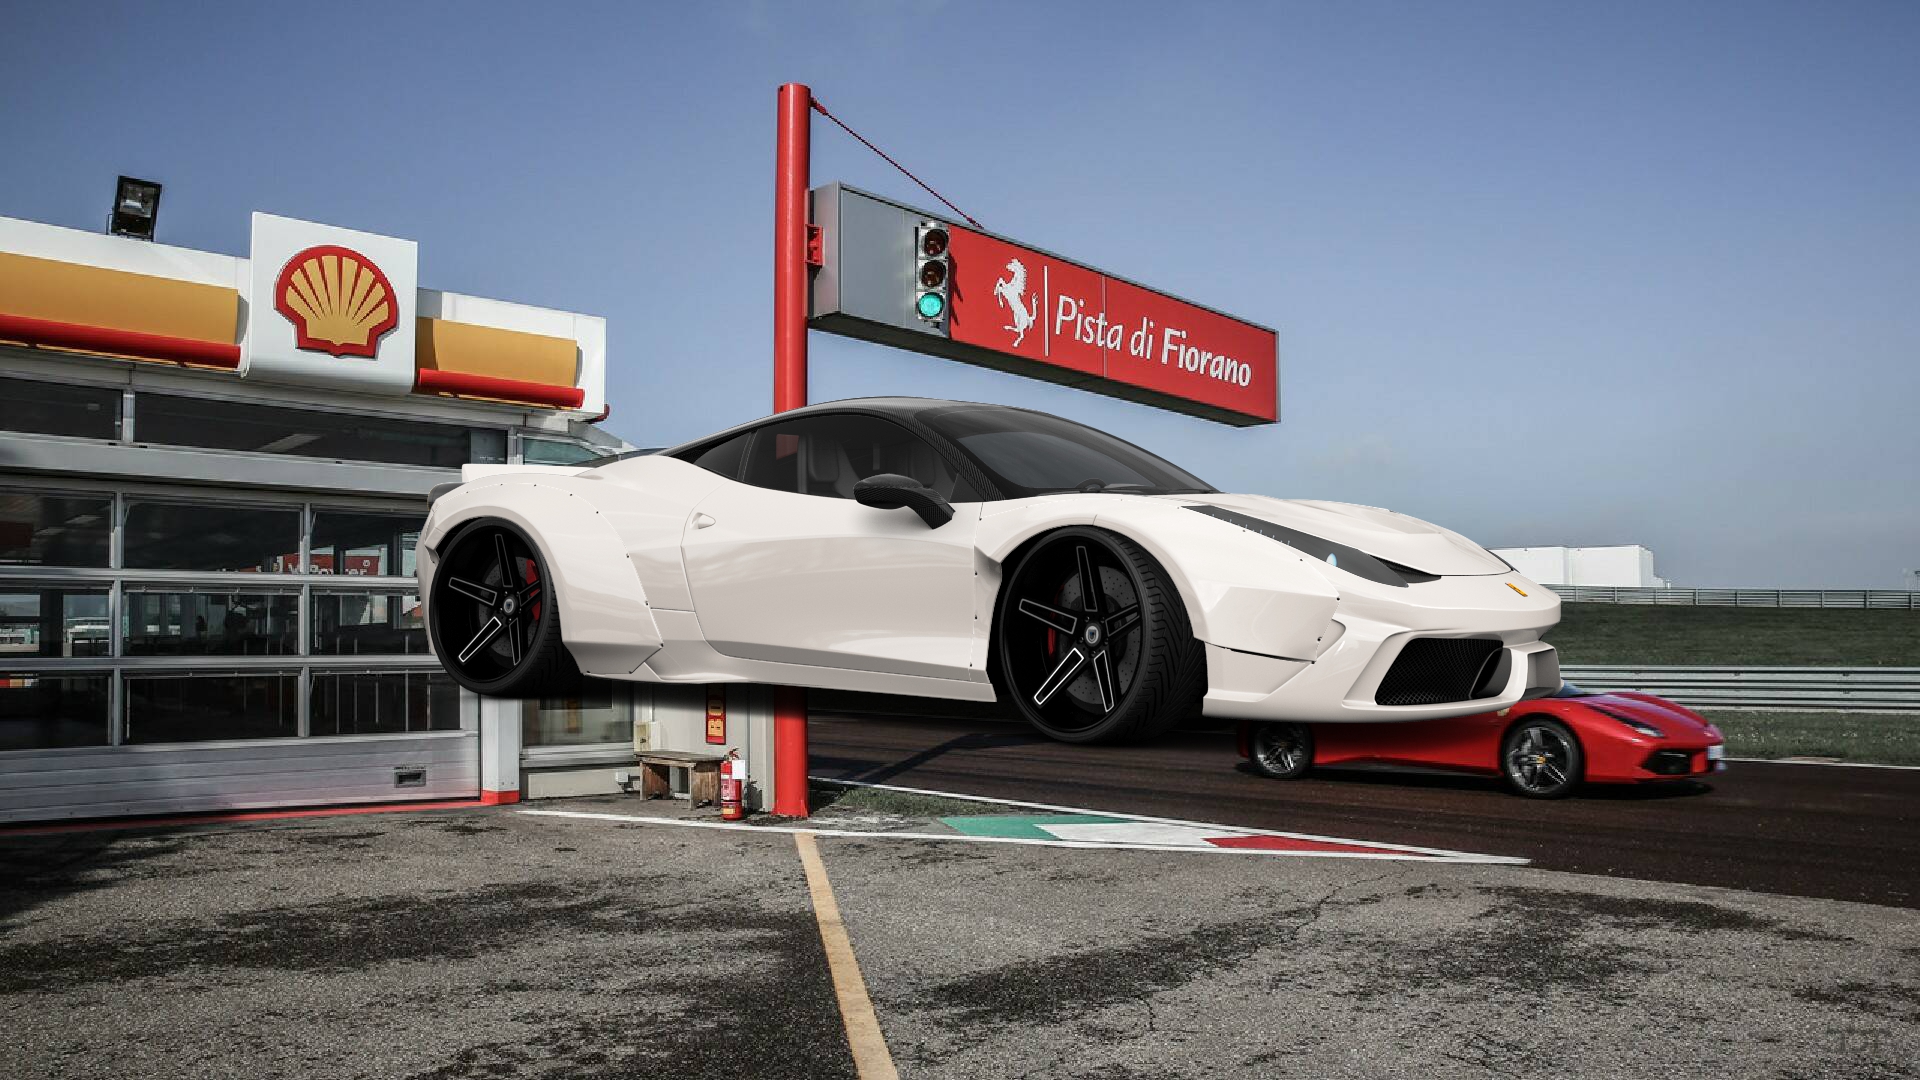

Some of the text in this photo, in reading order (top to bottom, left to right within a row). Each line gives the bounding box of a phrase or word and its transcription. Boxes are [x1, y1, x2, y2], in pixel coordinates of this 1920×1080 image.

[1055, 294, 1252, 387] Pista di Fiorano
